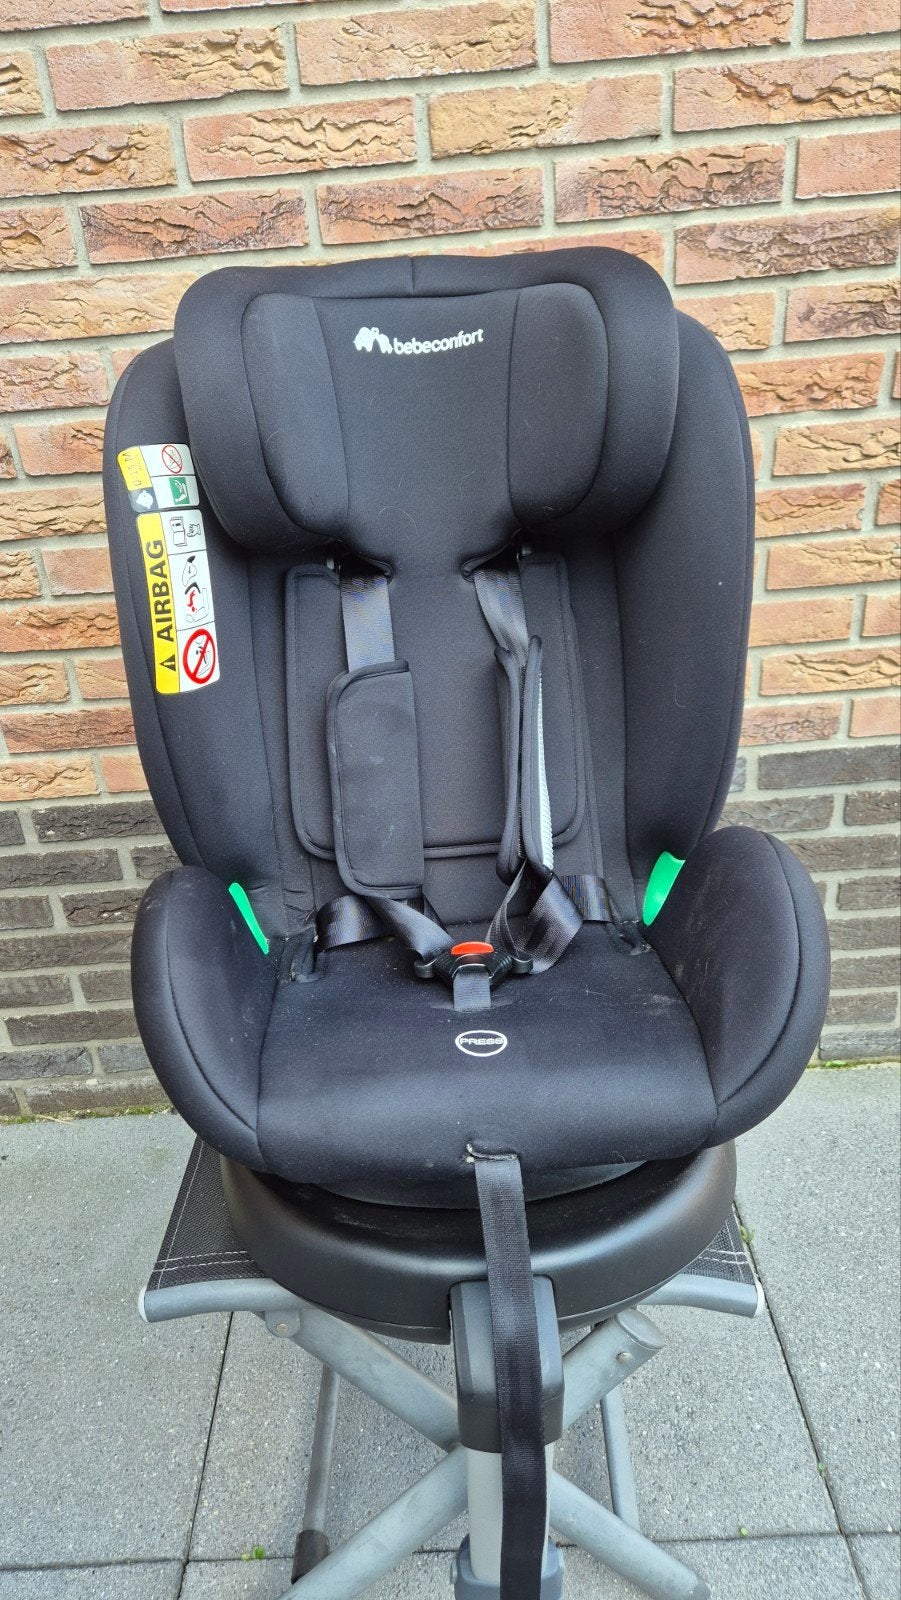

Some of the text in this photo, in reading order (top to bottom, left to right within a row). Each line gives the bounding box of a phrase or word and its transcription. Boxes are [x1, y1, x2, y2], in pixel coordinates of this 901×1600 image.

[393, 328, 484, 355] bebeconfort
[145, 539, 175, 642] AIRBAG
[460, 1037, 503, 1045] PRESS
